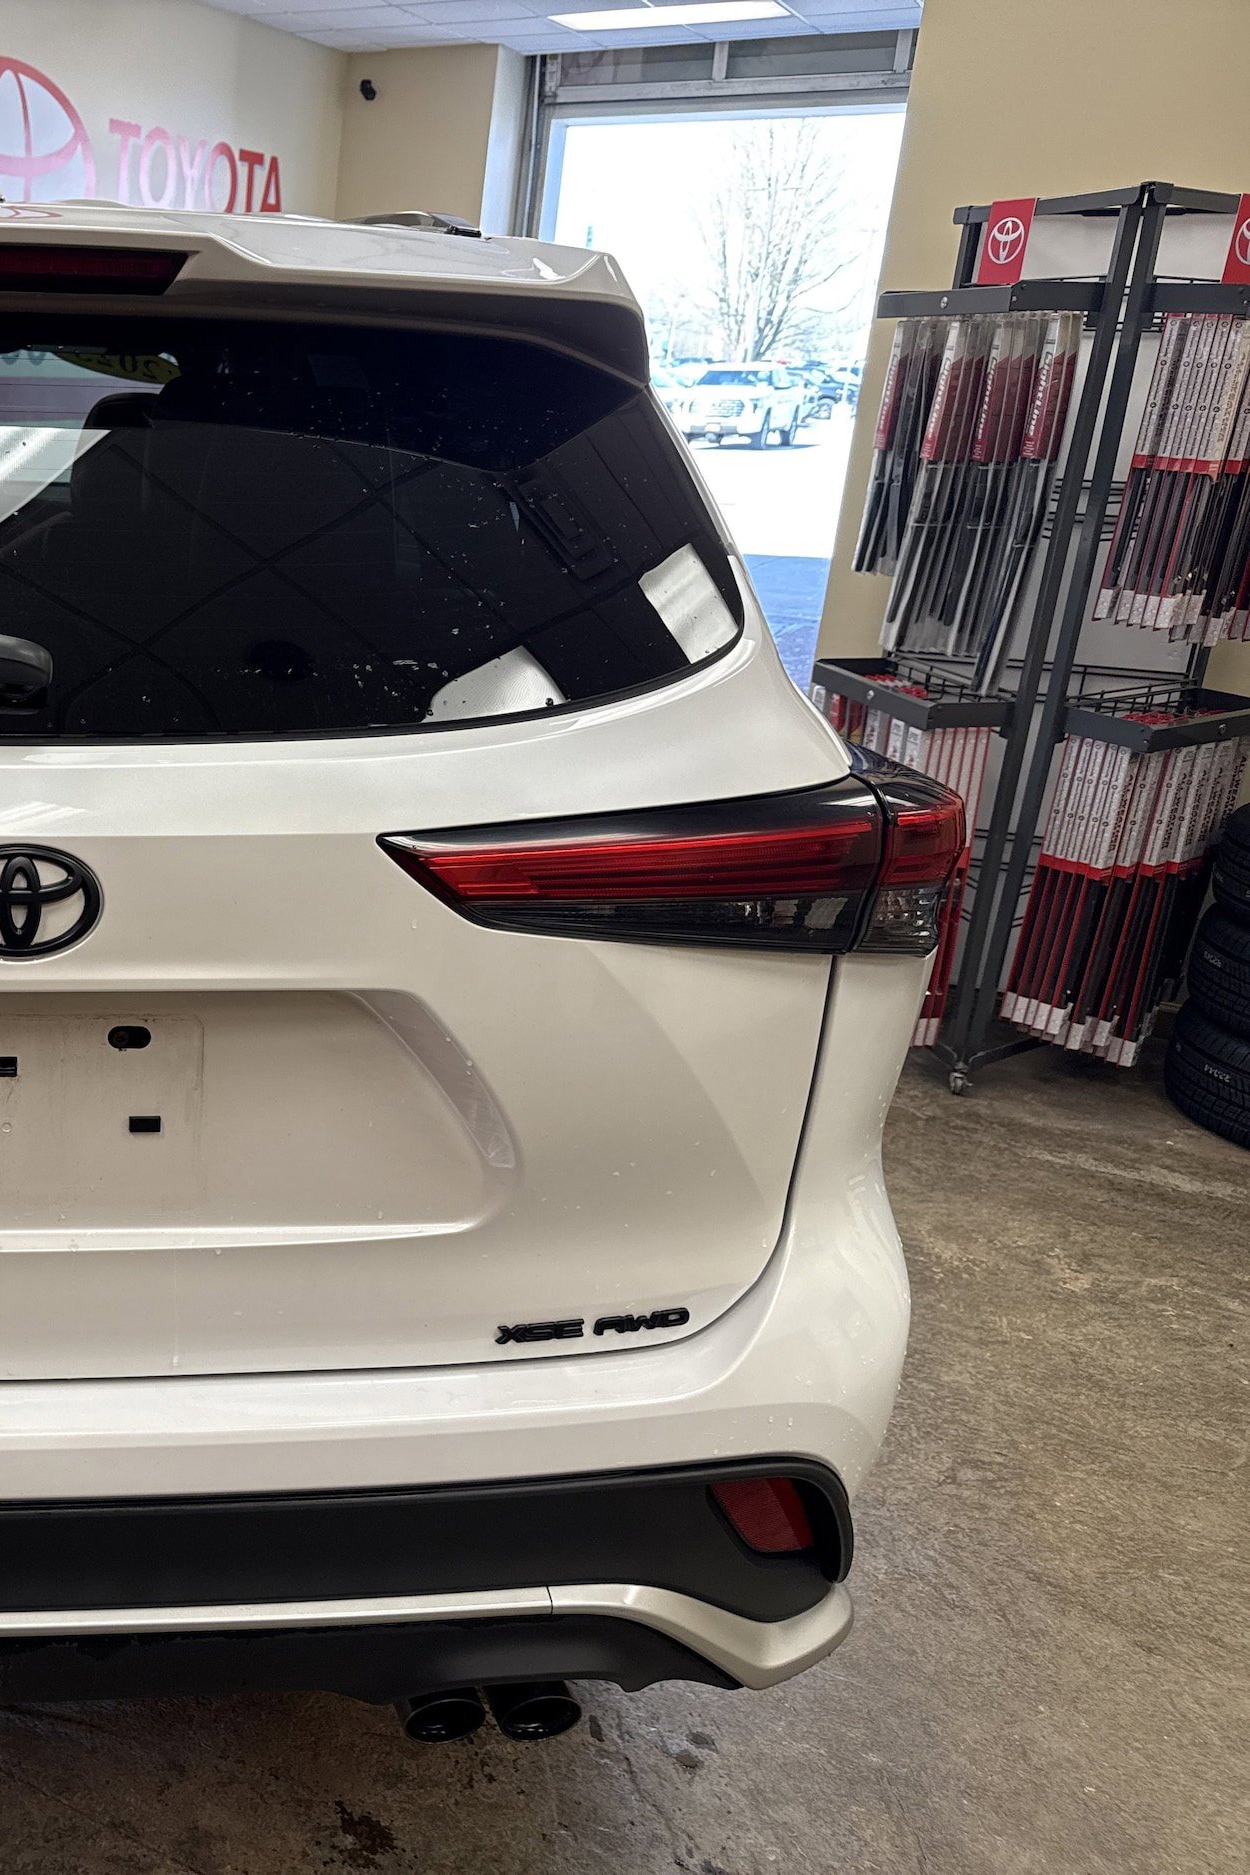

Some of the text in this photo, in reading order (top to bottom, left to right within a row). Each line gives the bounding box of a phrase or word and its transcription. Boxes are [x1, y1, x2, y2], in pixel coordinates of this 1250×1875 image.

[109, 118, 282, 213] TOYOTA
[495, 1307, 690, 1344] XSE AWD
